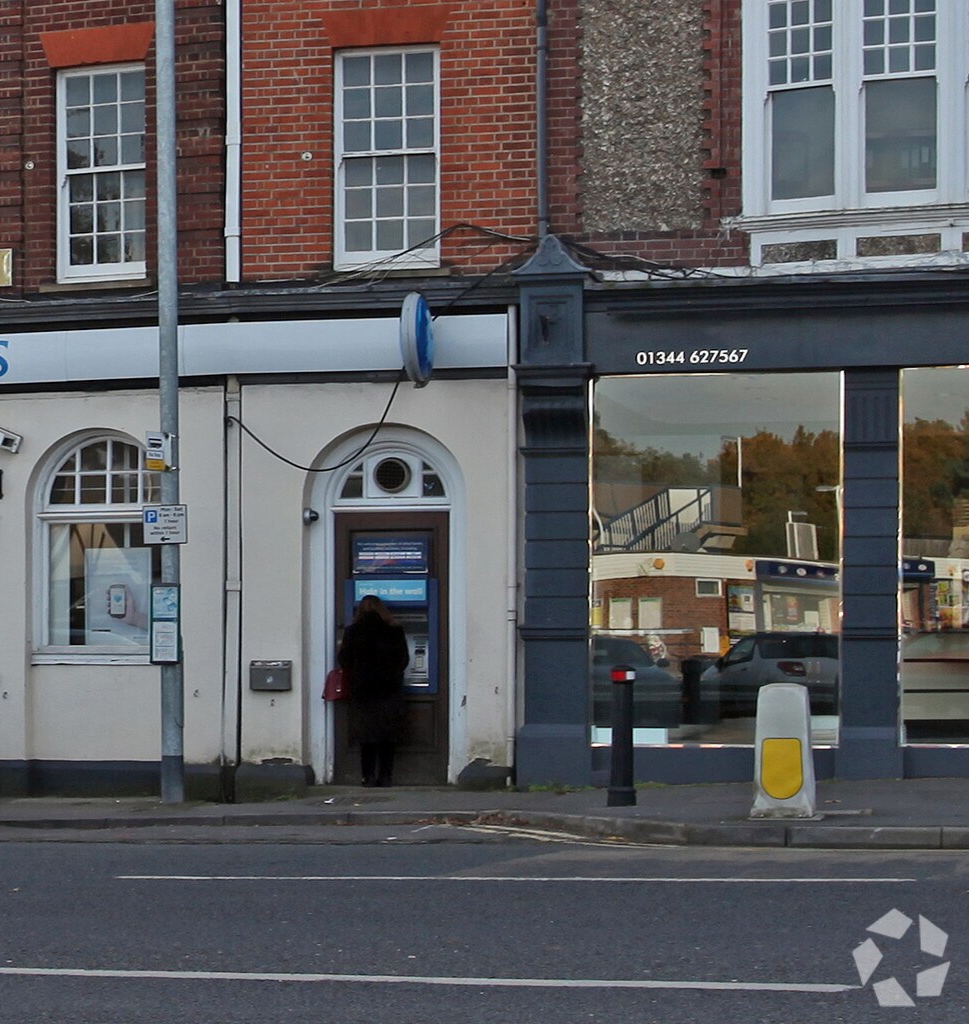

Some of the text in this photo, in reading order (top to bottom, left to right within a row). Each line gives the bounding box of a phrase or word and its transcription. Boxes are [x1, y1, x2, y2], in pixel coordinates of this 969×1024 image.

[636, 349, 749, 365] 01344 627567
[147, 511, 156, 522] P
[359, 587, 423, 595] Hole in the wall
